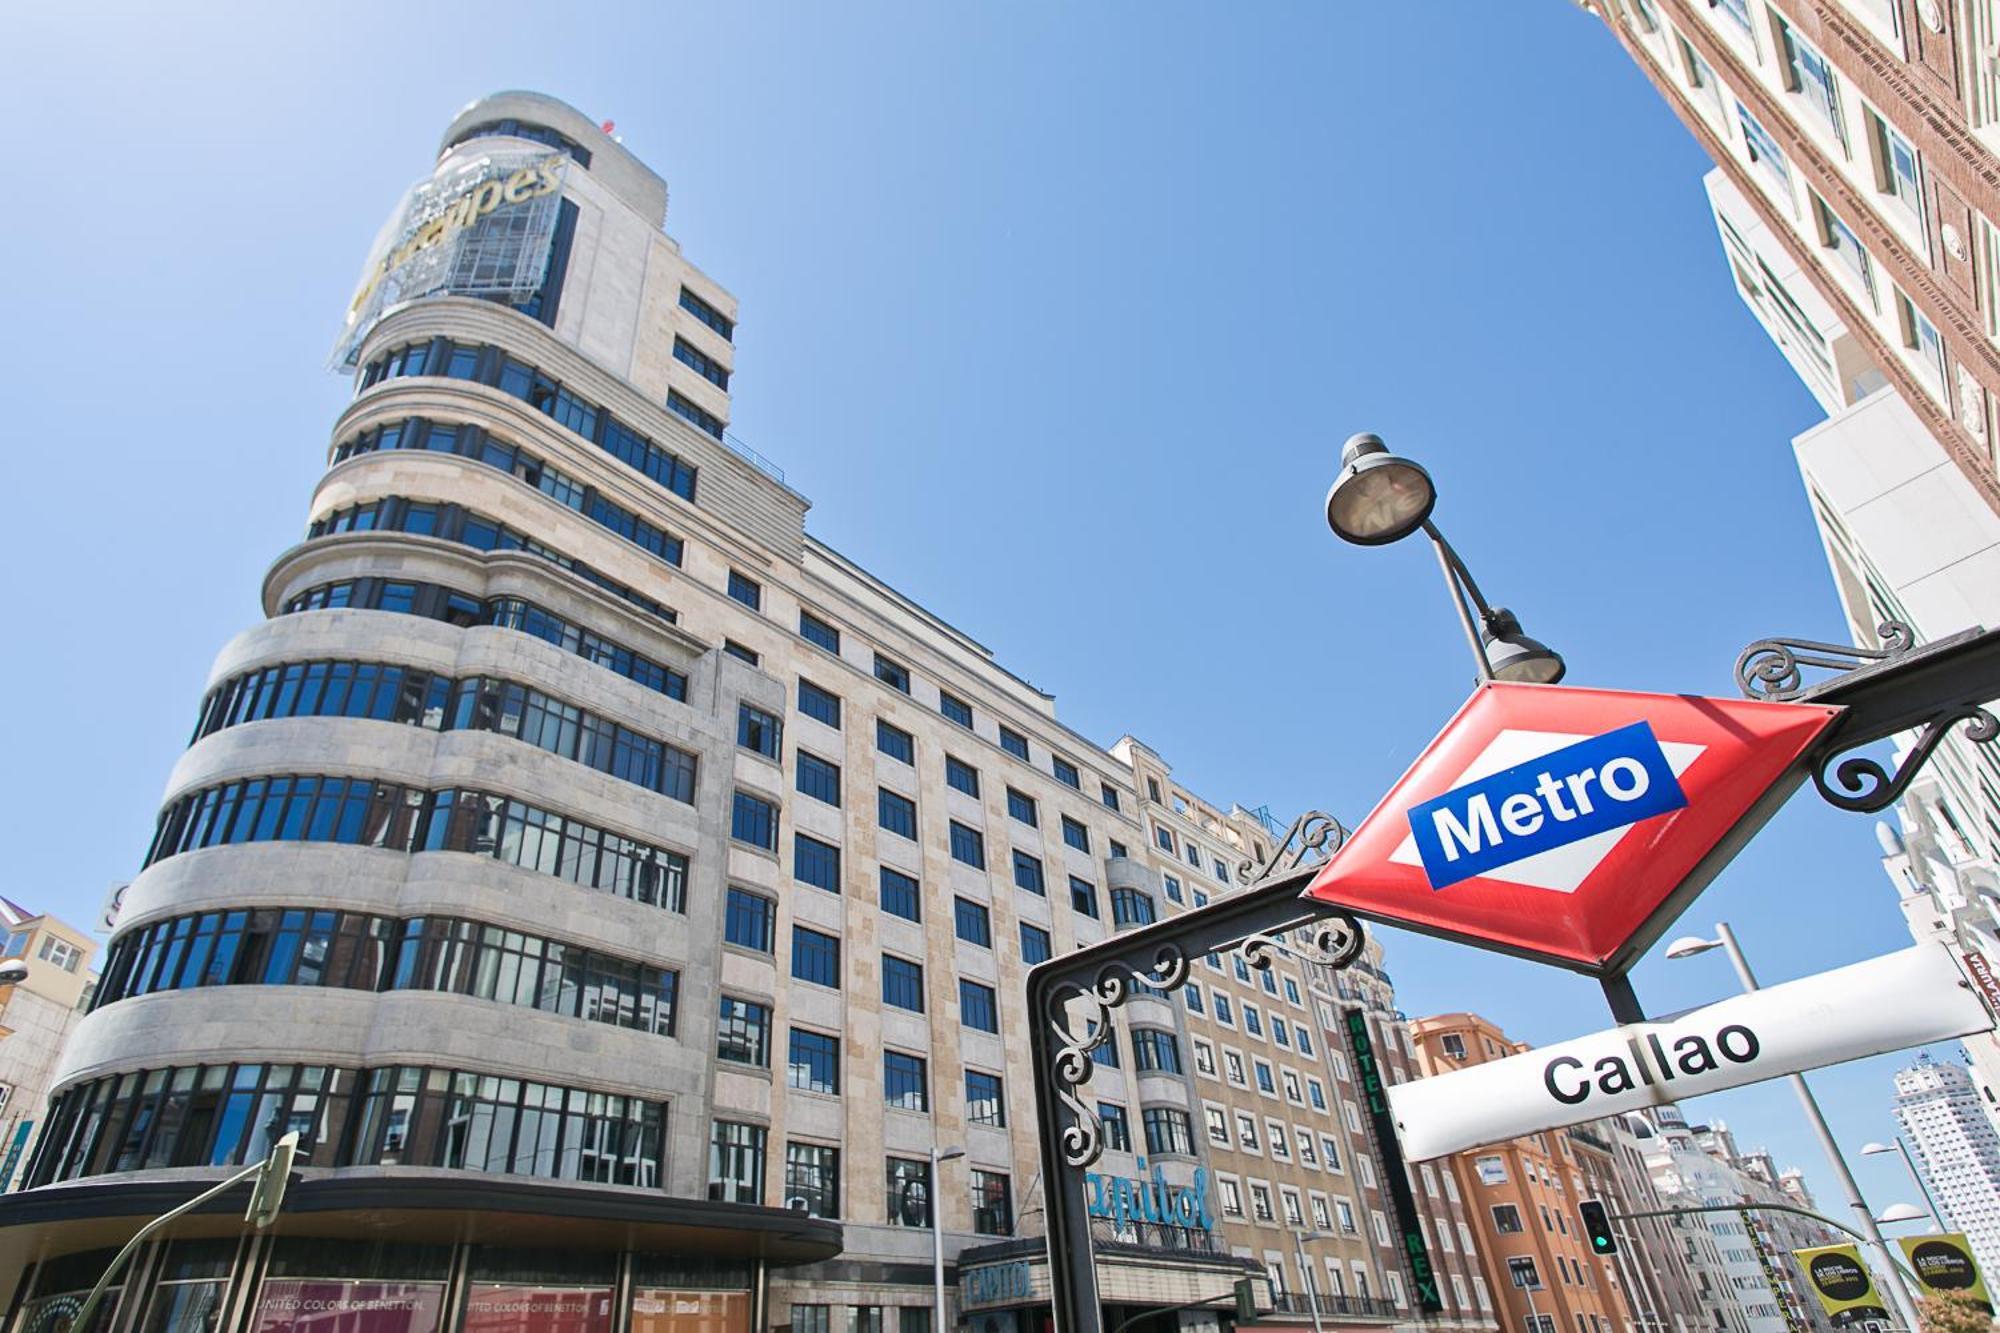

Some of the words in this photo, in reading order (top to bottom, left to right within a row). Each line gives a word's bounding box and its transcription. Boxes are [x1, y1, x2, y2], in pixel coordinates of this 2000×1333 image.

[1431, 755, 1650, 863] Metro
[1543, 1023, 1761, 1105] Callao
[1085, 1155, 1214, 1233] apitol
[1349, 1015, 1385, 1114] HOTEL
[1406, 1233, 1438, 1303] REX
[302, 1300, 350, 1311] COLORS
[965, 1259, 1036, 1303] CAPITOL
